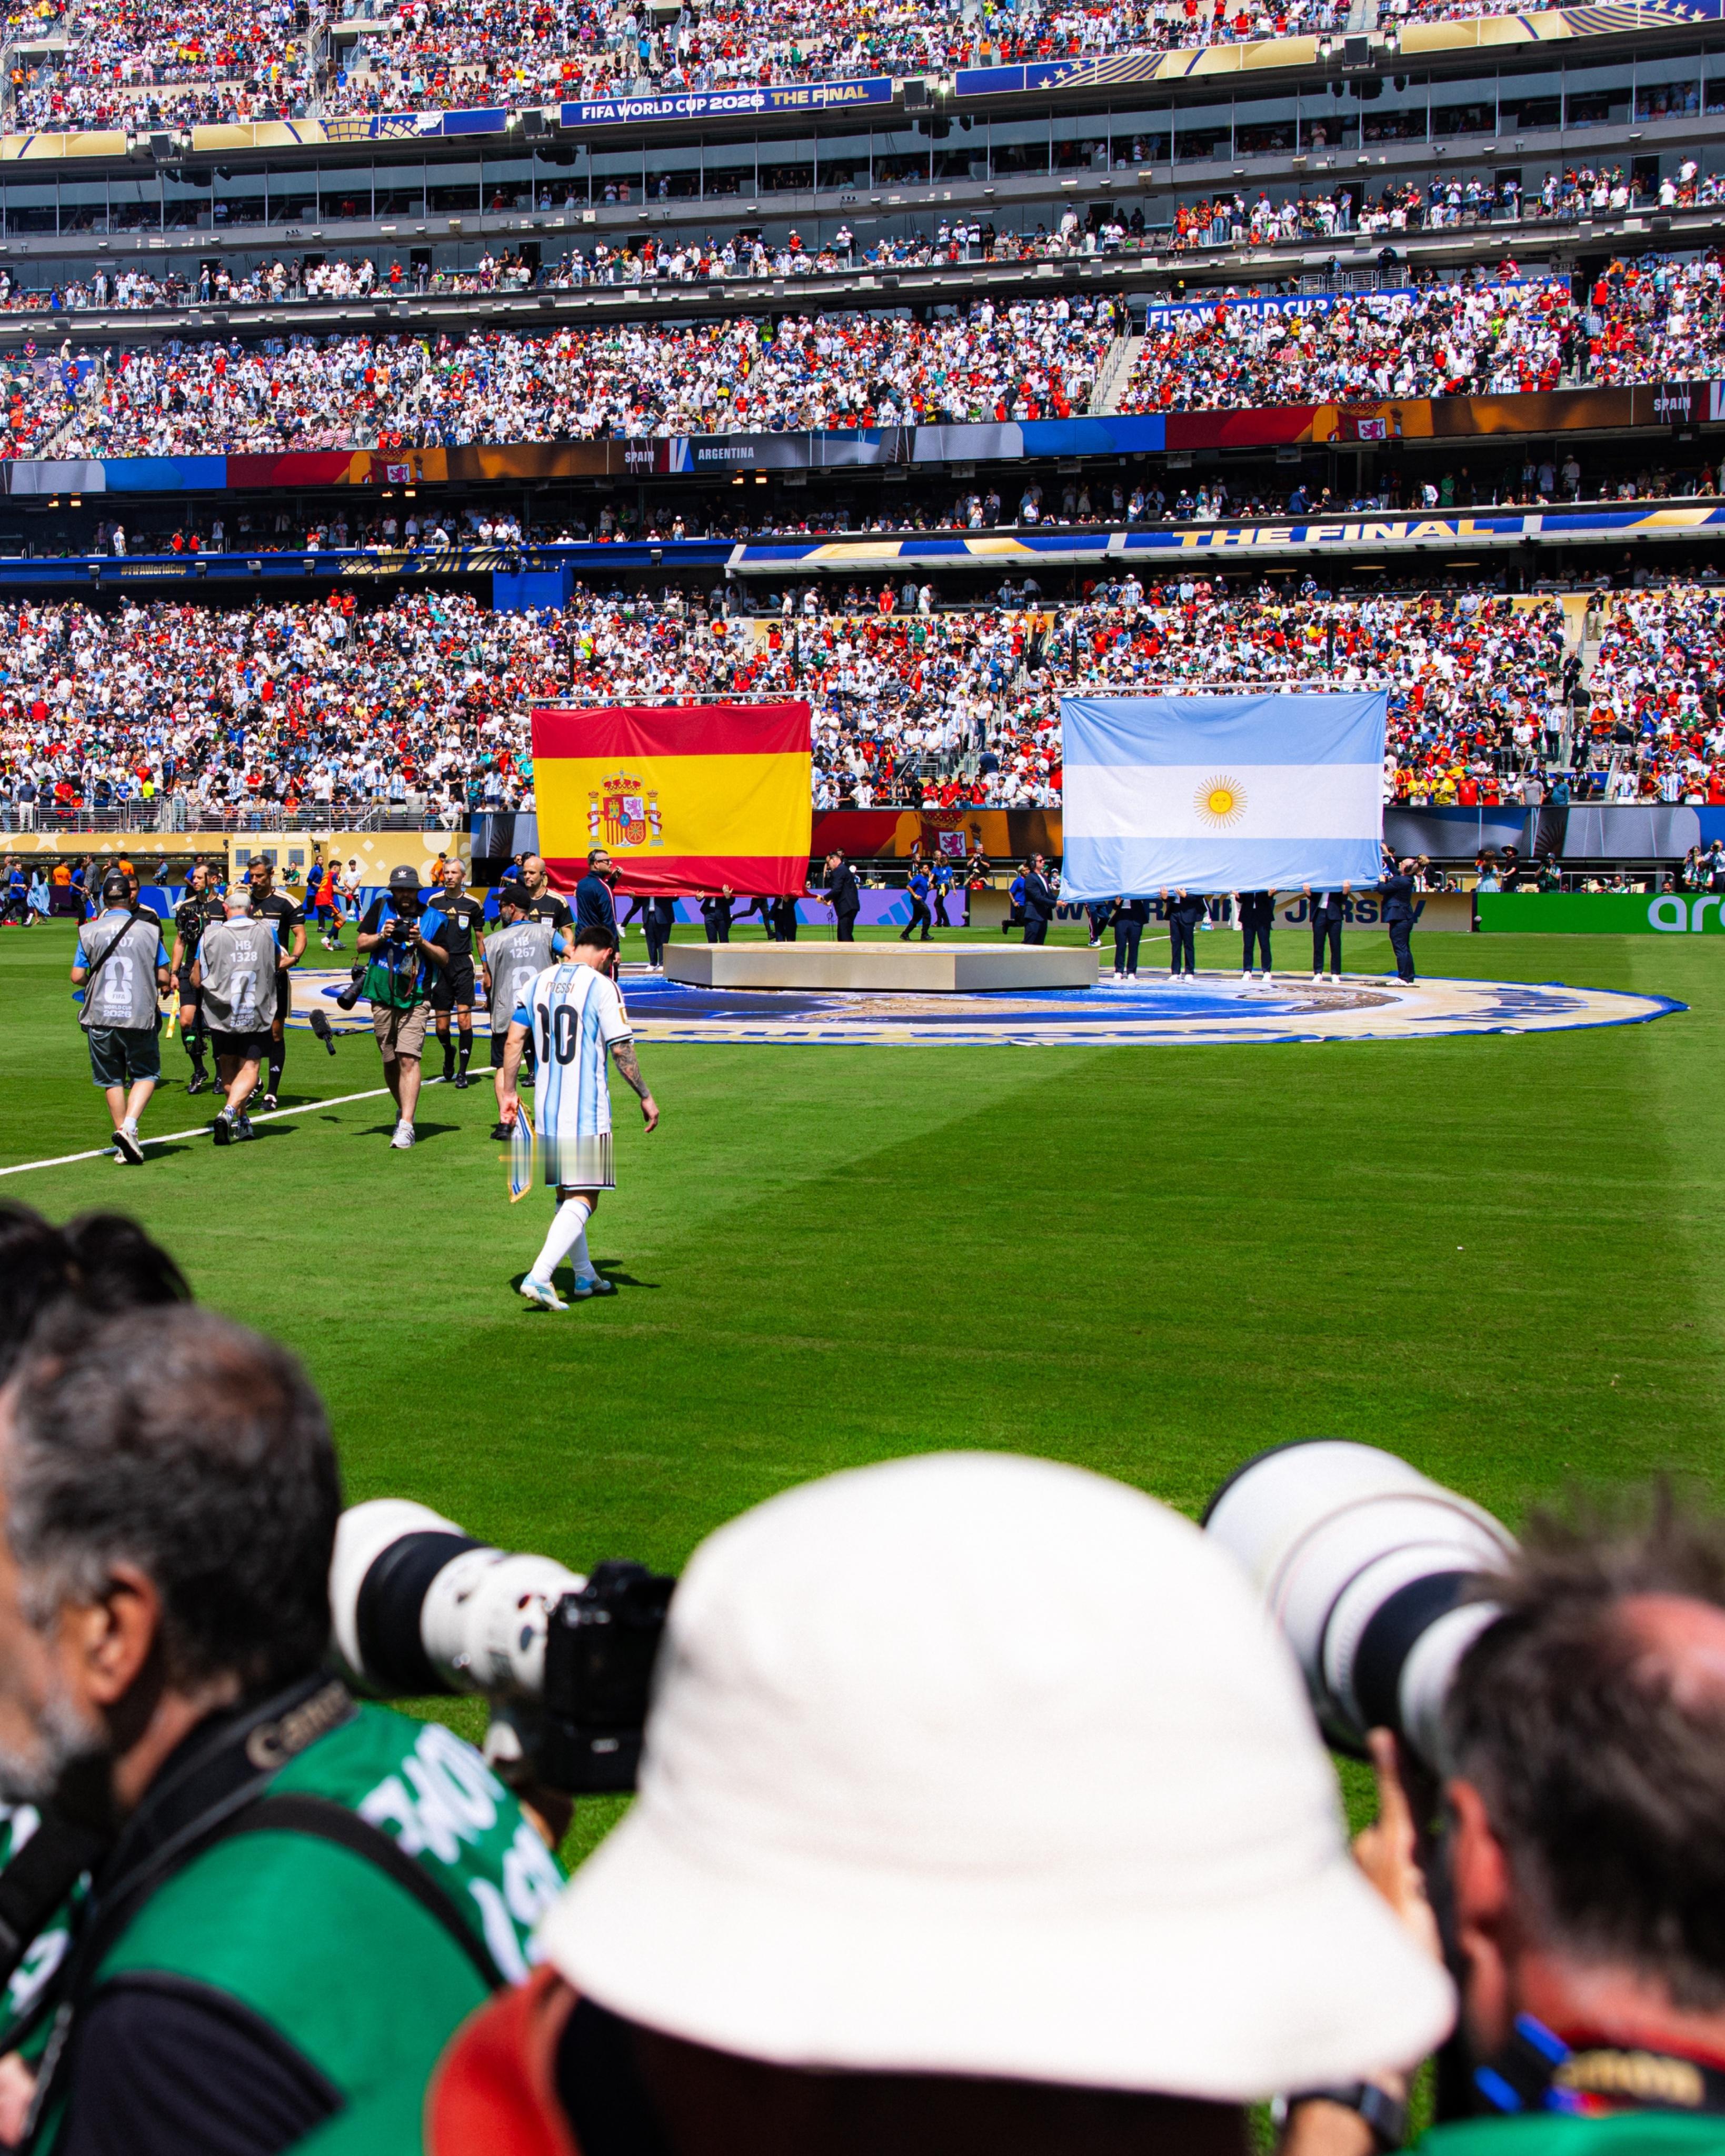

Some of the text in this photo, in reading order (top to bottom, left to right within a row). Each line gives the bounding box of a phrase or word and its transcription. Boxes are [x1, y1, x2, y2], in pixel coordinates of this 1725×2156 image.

[582, 85, 869, 119] FIFA WORLD CUP 2026 THE FINAL
[1653, 396, 1691, 411] SPAIN
[624, 451, 654, 463] SPAIN
[698, 447, 754, 460] ARGENTINA
[1172, 520, 1493, 547] THE FINAL
[121, 563, 186, 576] #FIFAWorldCup
[1648, 895, 1725, 932] ar
[105, 936, 134, 947] 107
[235, 941, 252, 951] HB
[514, 937, 529, 947] HB
[230, 952, 258, 963] 1328
[510, 947, 535, 959] 1267
[545, 981, 575, 994] MESSI
[536, 1003, 578, 1065] 10
